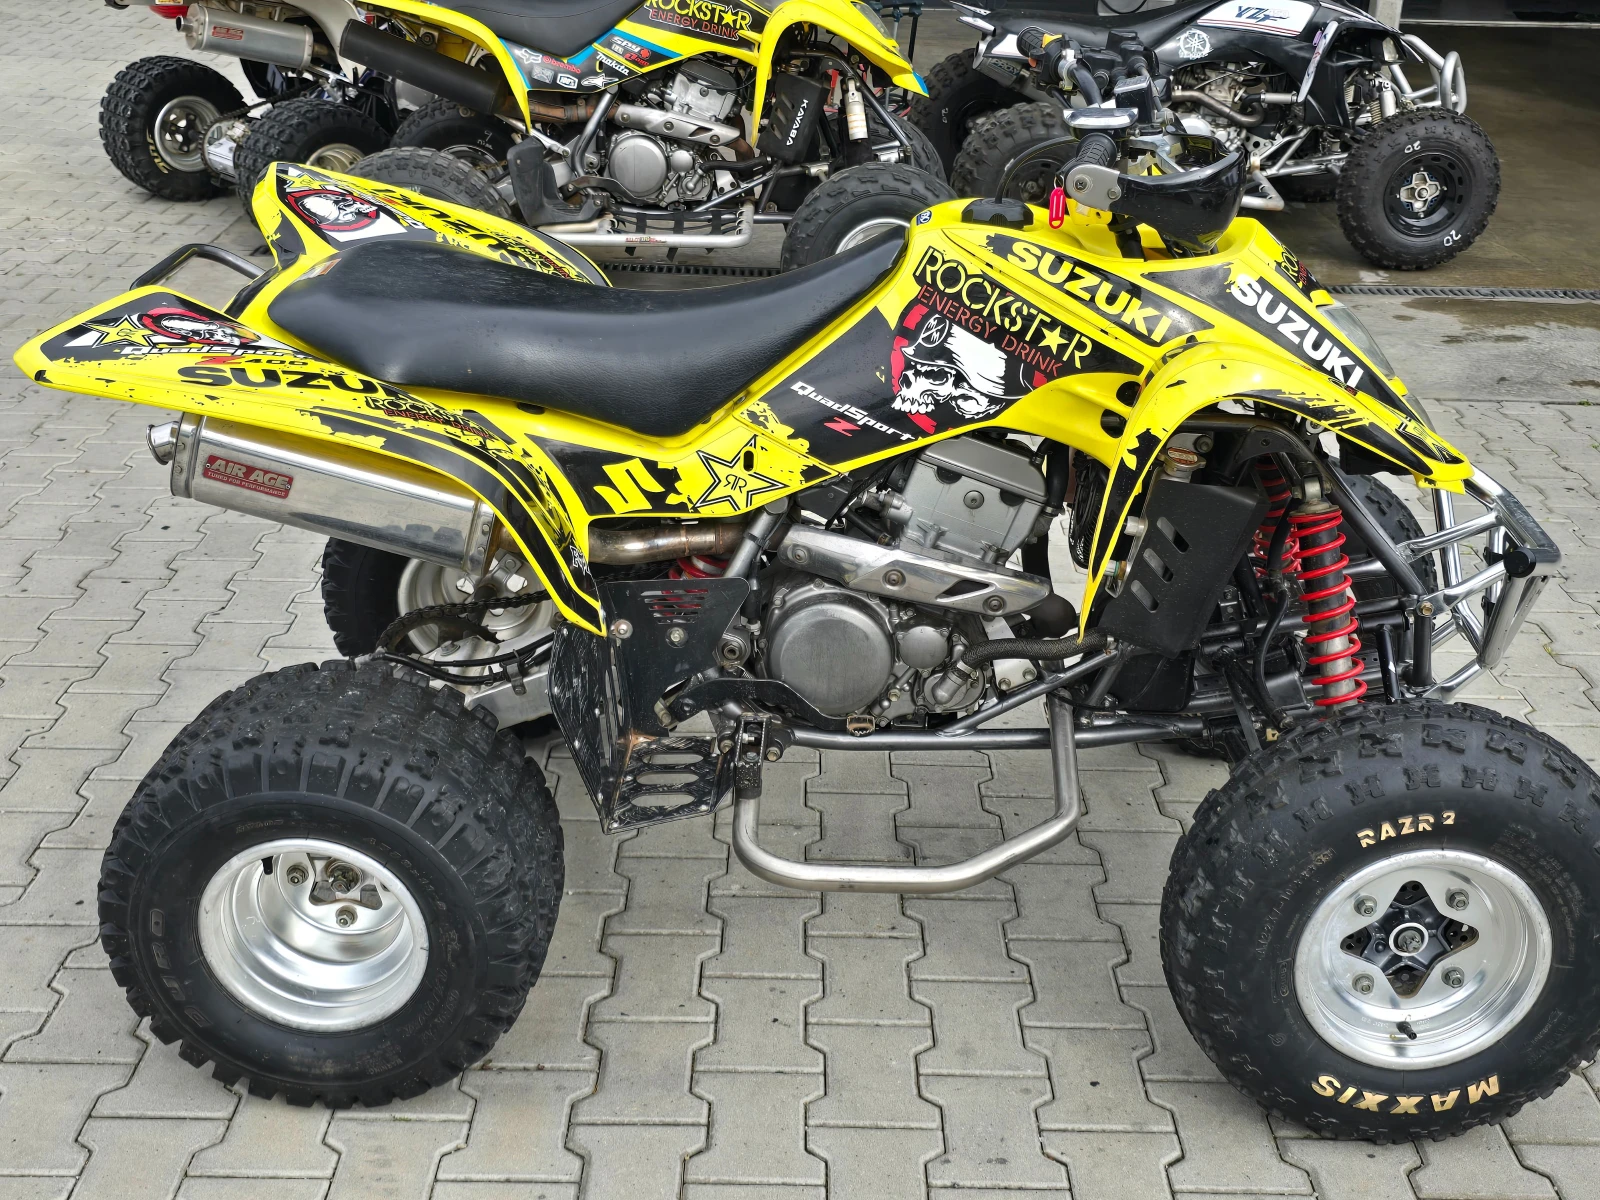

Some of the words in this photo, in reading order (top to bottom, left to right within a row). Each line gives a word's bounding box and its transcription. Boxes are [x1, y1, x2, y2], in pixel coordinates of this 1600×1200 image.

[650, 8, 699, 29] ENERGY
[701, 20, 739, 39] DRINK
[1006, 241, 1173, 344] SUZUKI
[916, 284, 998, 340] ENERGY
[1001, 334, 1064, 377] DRINK
[1230, 273, 1365, 389] SUZUKI
[383, 408, 444, 426] ENERGY
[789, 380, 916, 441] QuadSport
[823, 416, 862, 438] Z
[207, 471, 228, 482] TUNED
[241, 481, 286, 497] PERFORMANCE
[210, 459, 247, 478] AIR
[249, 470, 289, 490] AGE
[1356, 813, 1435, 848] RAZR
[1441, 810, 1456, 825] 2
[1310, 1074, 1500, 1115] MAXXIS
